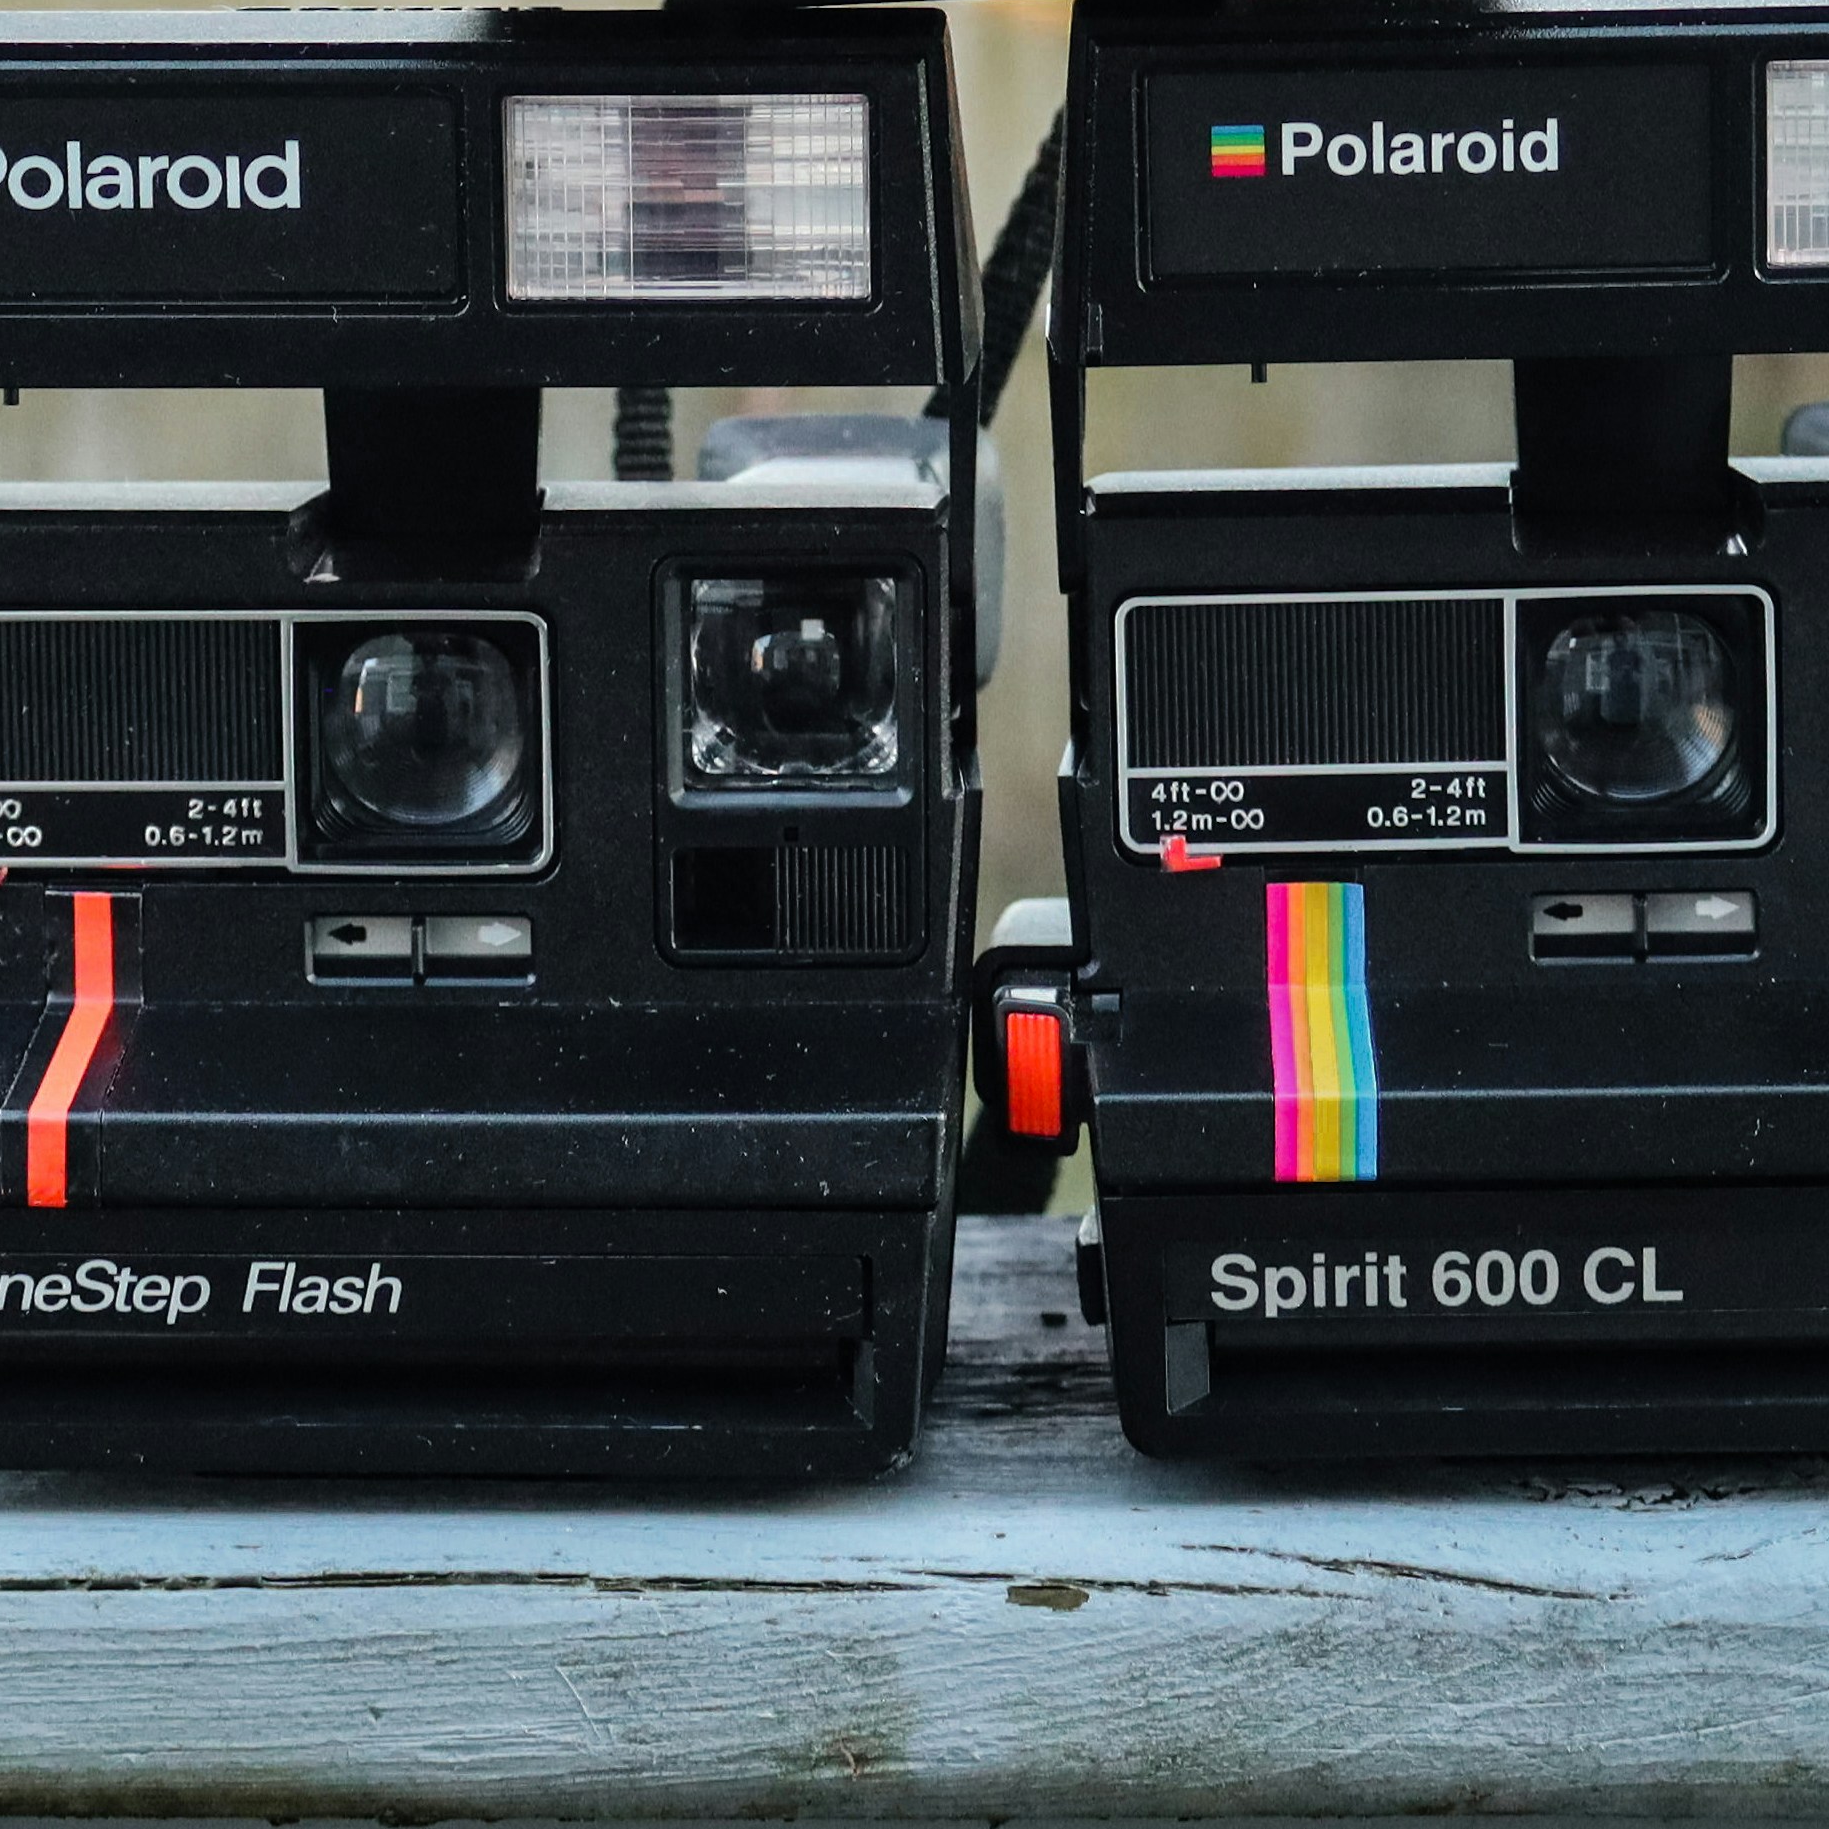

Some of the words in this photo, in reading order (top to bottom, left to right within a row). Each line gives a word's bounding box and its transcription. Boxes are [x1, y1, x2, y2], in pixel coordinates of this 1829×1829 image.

[1280, 117, 1560, 176] Polaroid
[1366, 805, 1487, 829] 0.6-1.2m
[242, 1261, 403, 1314] Flash
[1210, 1252, 1408, 1319] Spirit
[1431, 1249, 1560, 1307] 600
[1582, 1247, 1685, 1304] CL
